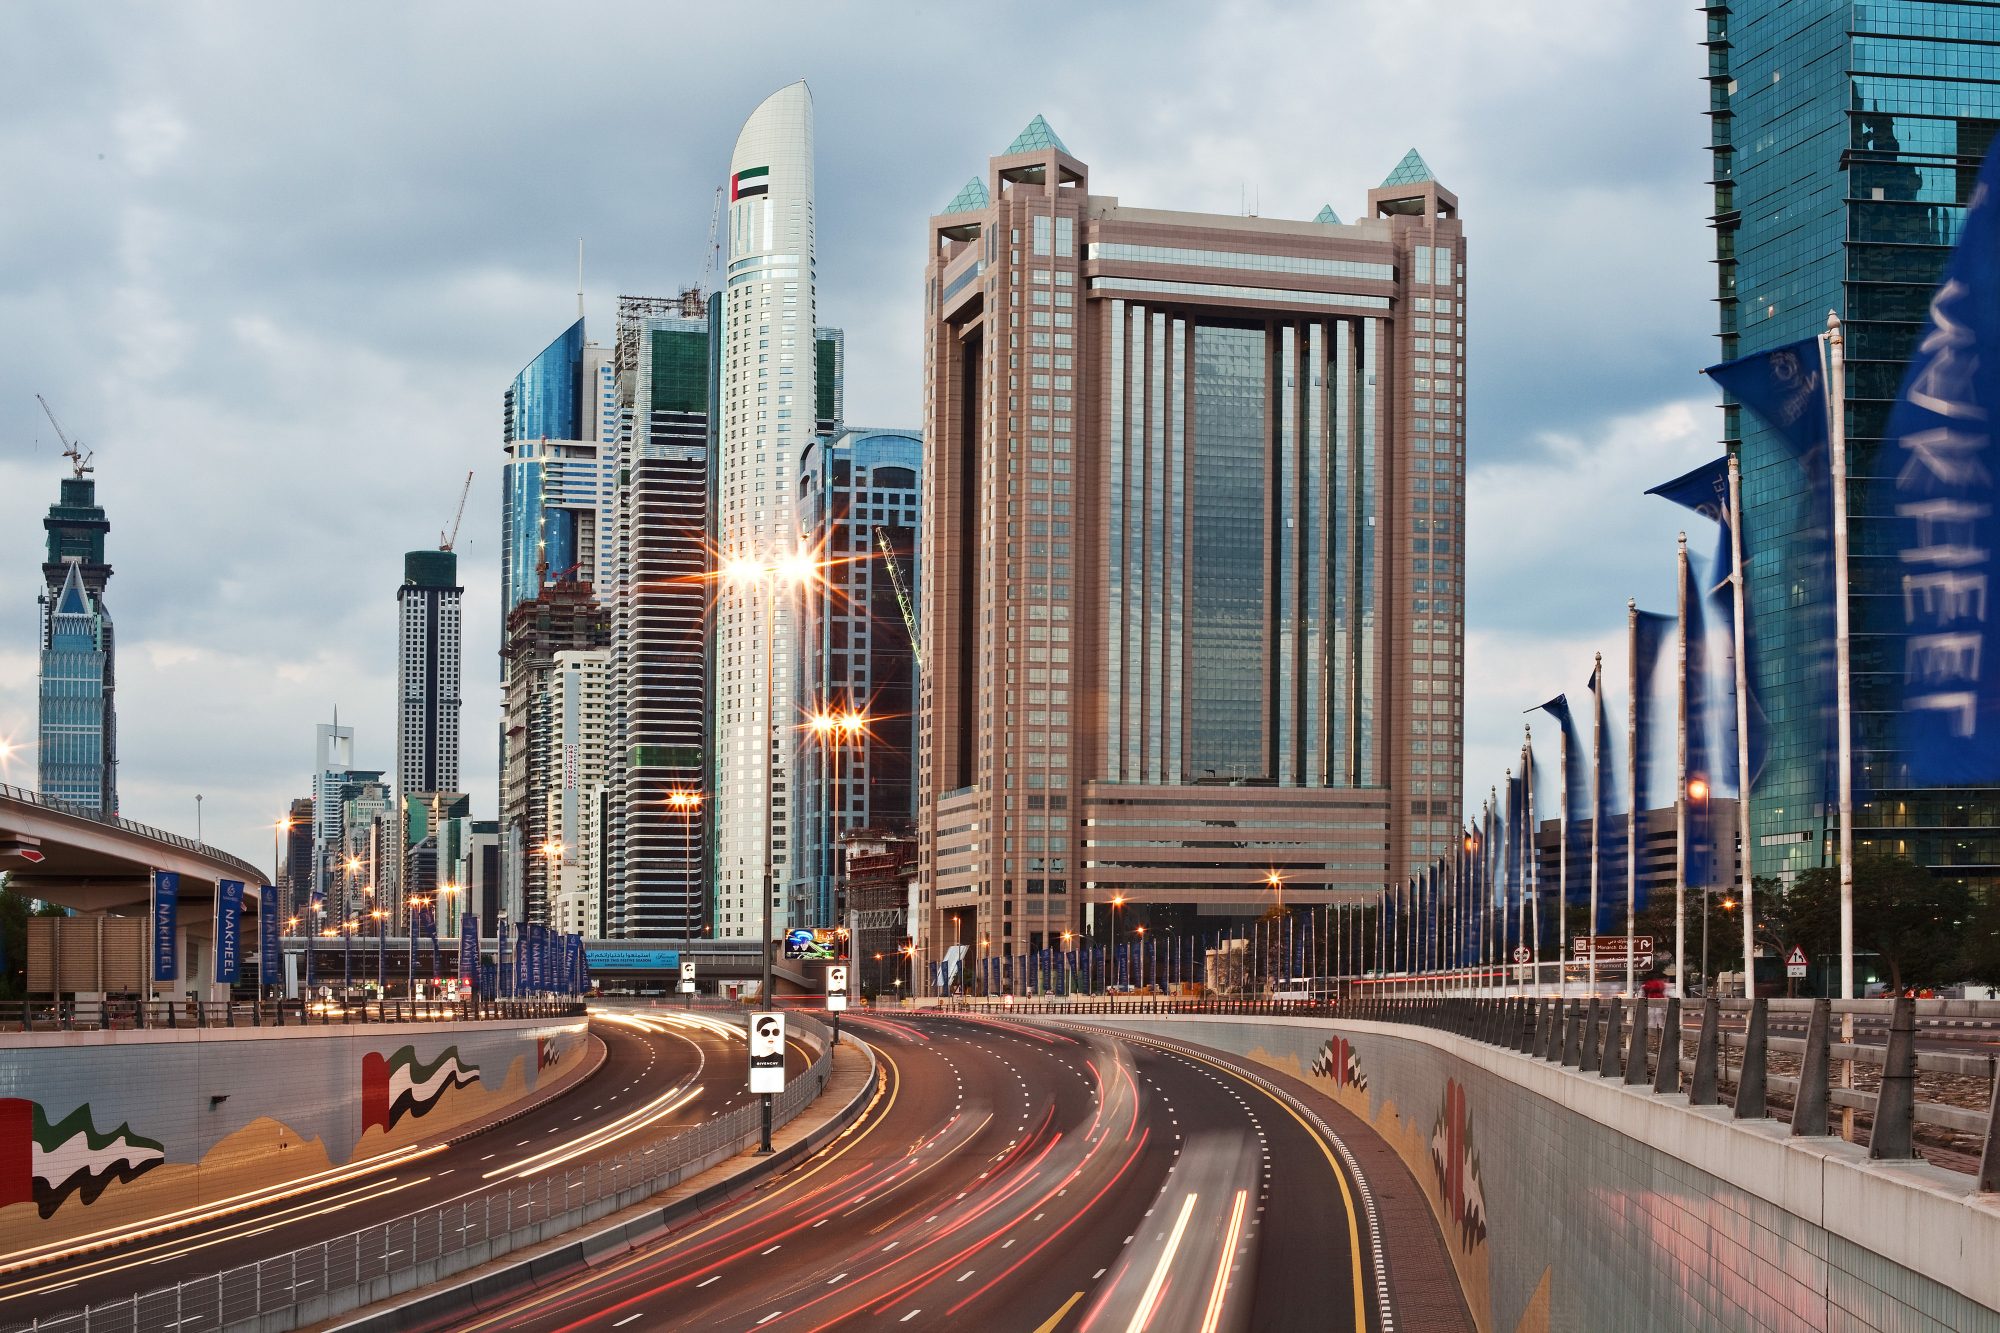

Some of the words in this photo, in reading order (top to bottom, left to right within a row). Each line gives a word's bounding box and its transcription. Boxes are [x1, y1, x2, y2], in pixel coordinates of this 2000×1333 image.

[158, 903, 172, 973] NAKHEEL
[224, 909, 235, 976] NAKHEEL
[532, 943, 541, 986] NAKHEEL
